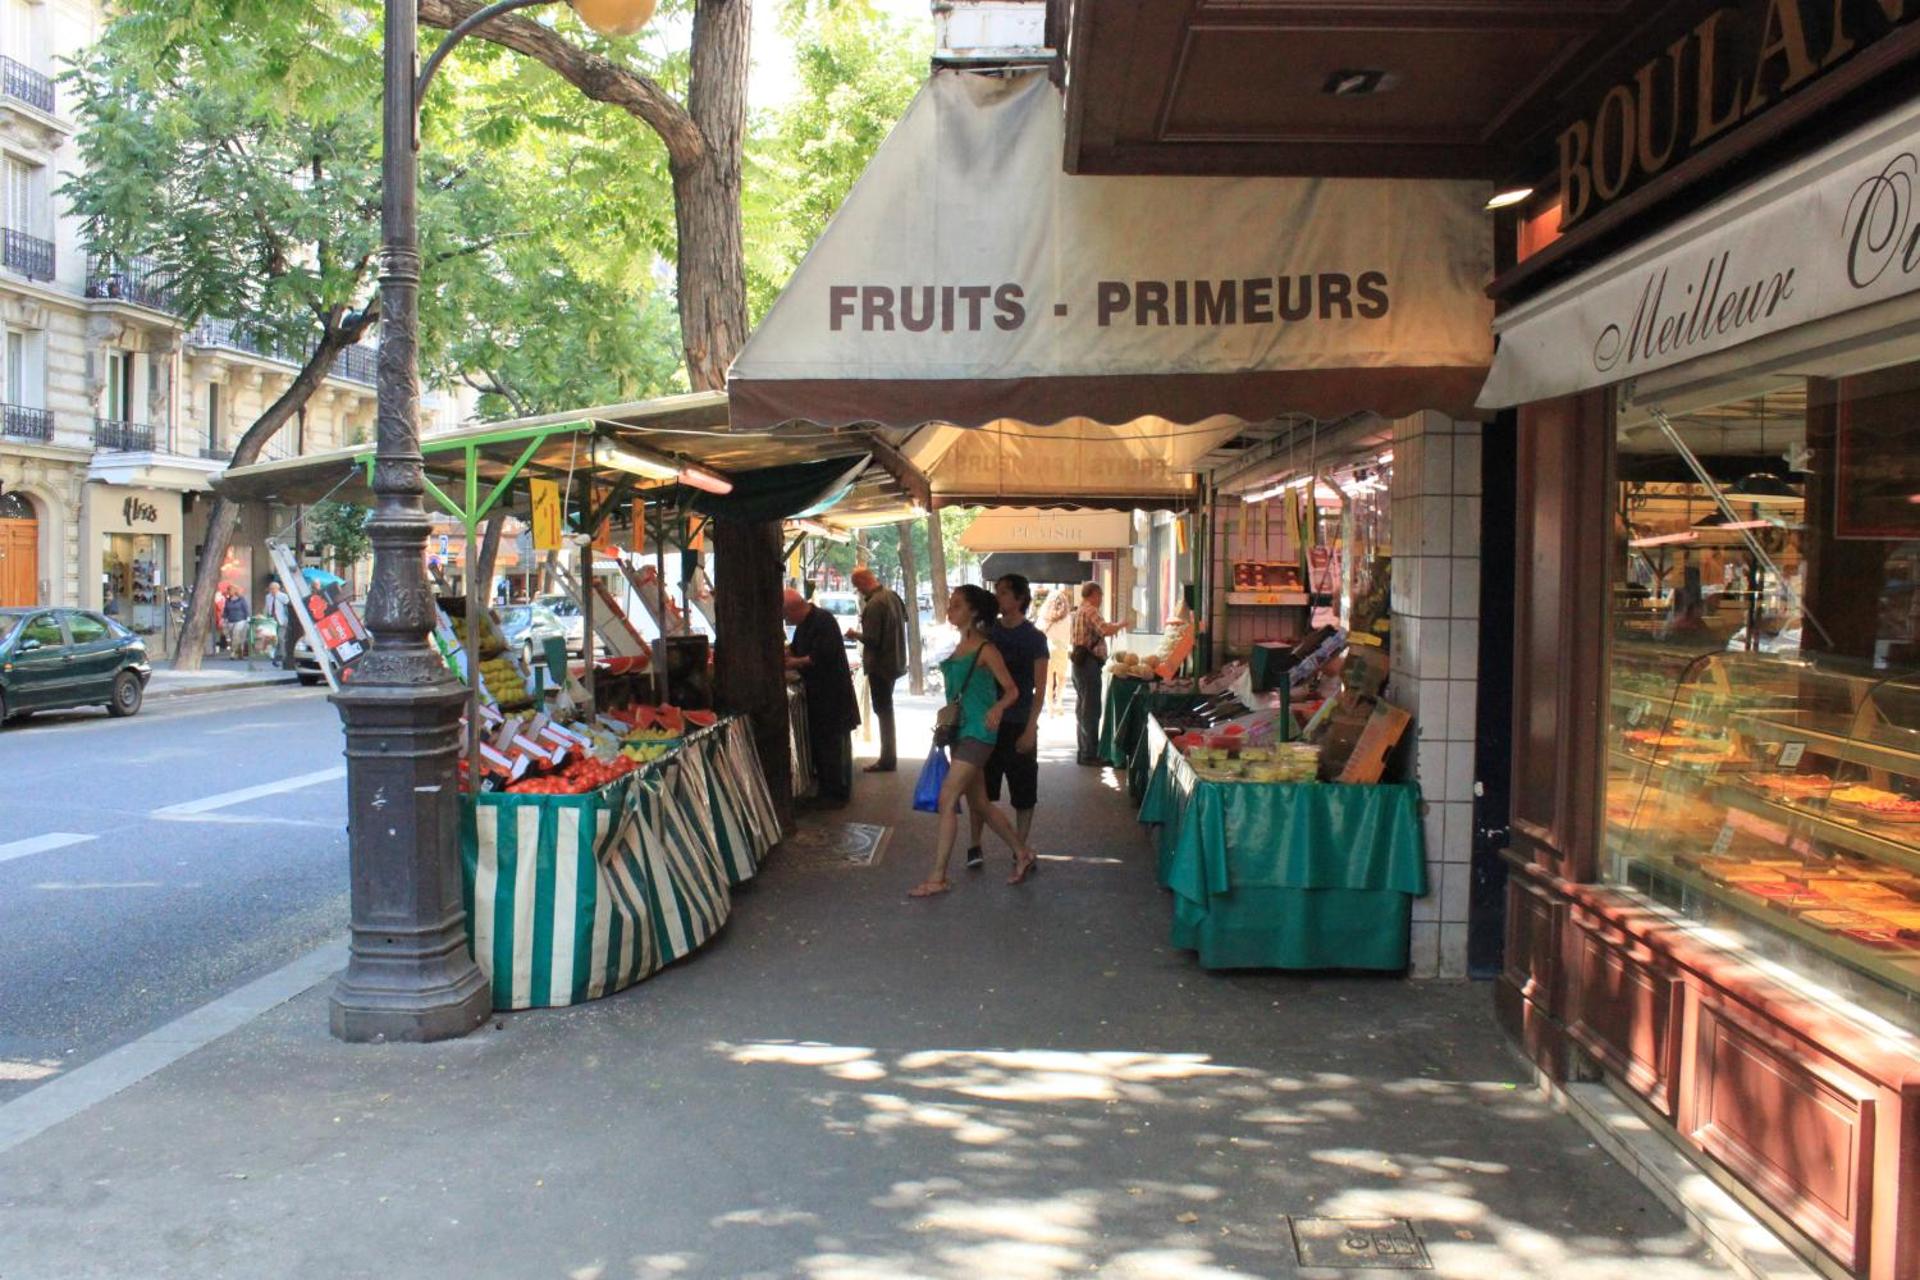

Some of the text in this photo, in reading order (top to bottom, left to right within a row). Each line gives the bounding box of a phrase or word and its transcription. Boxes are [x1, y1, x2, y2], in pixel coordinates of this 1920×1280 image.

[829, 283, 1026, 332] FRUITS
[1097, 272, 1390, 327] PRIMEURS
[1593, 250, 1795, 373] Meilleur
